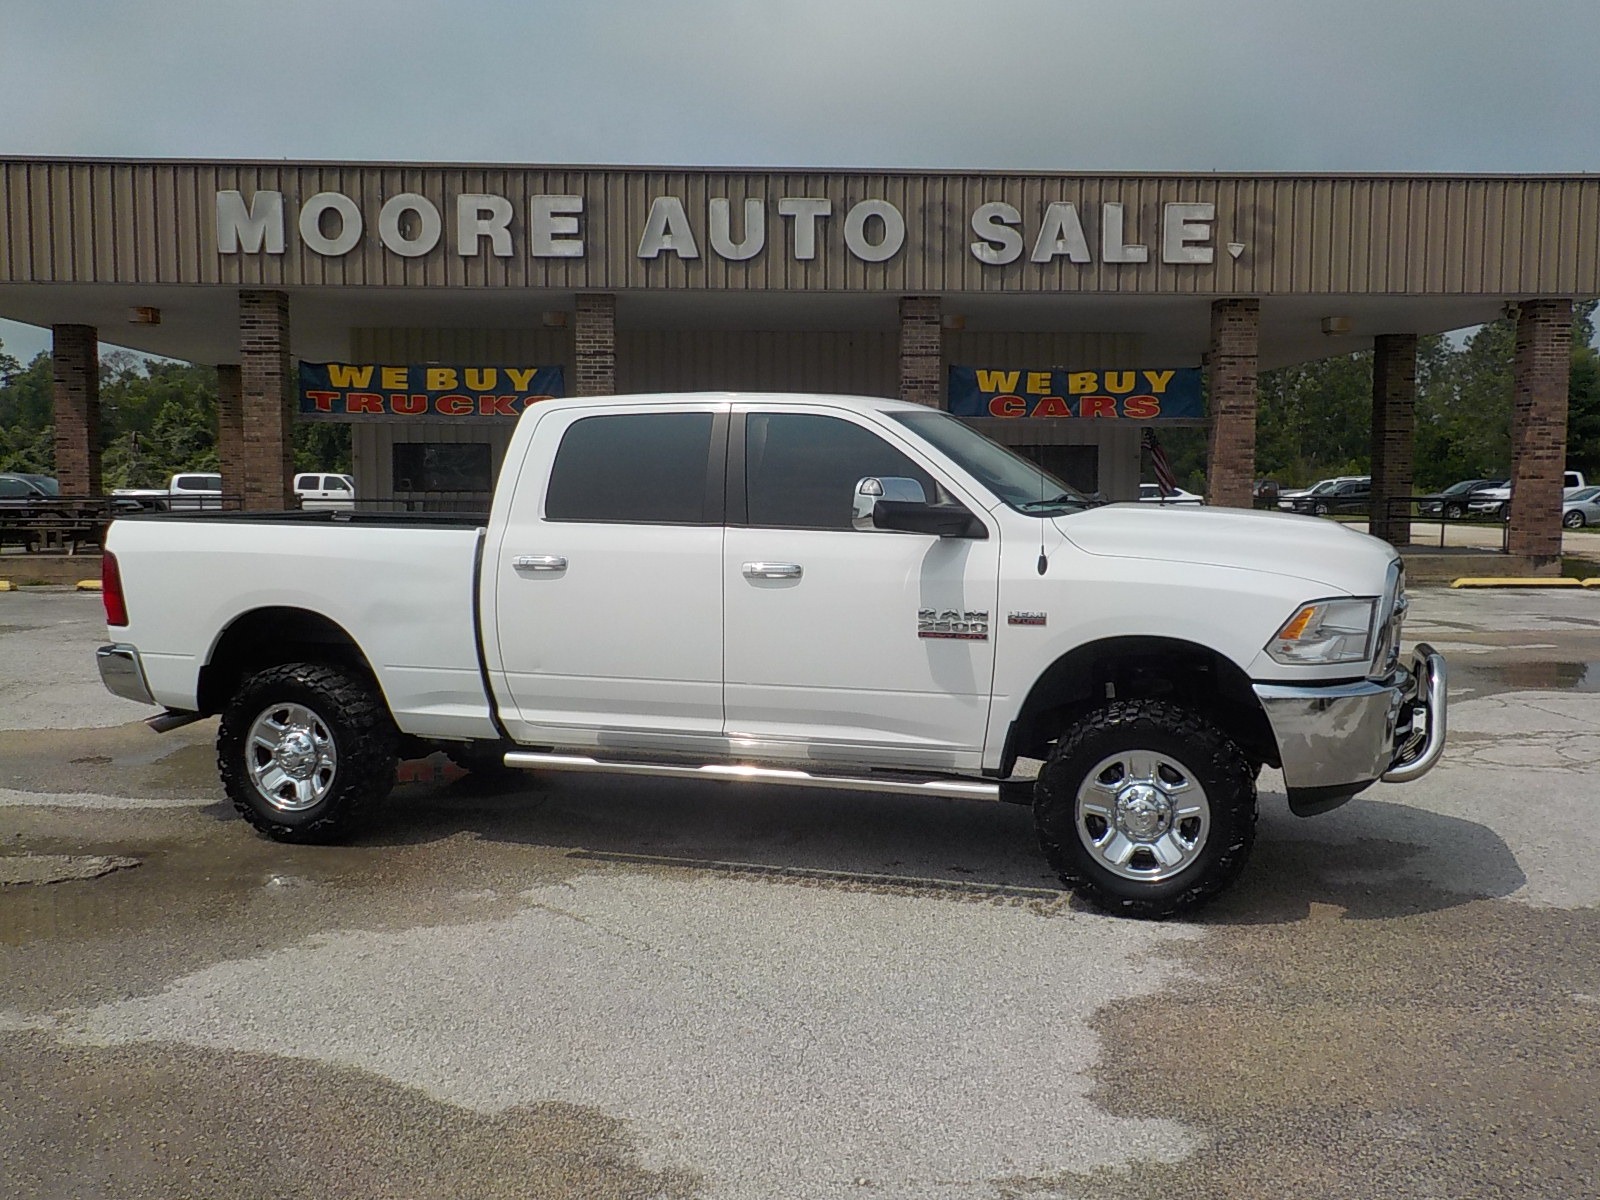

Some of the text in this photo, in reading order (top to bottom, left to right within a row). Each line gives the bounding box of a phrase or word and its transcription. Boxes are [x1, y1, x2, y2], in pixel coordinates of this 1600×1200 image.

[216, 189, 1246, 264] MOORE AUTO SALE
[327, 364, 538, 392] WE BUY
[976, 370, 1176, 394] WE BUY
[988, 395, 1161, 419] CARS
[918, 608, 988, 621] RAM
[918, 620, 988, 633] 2500
